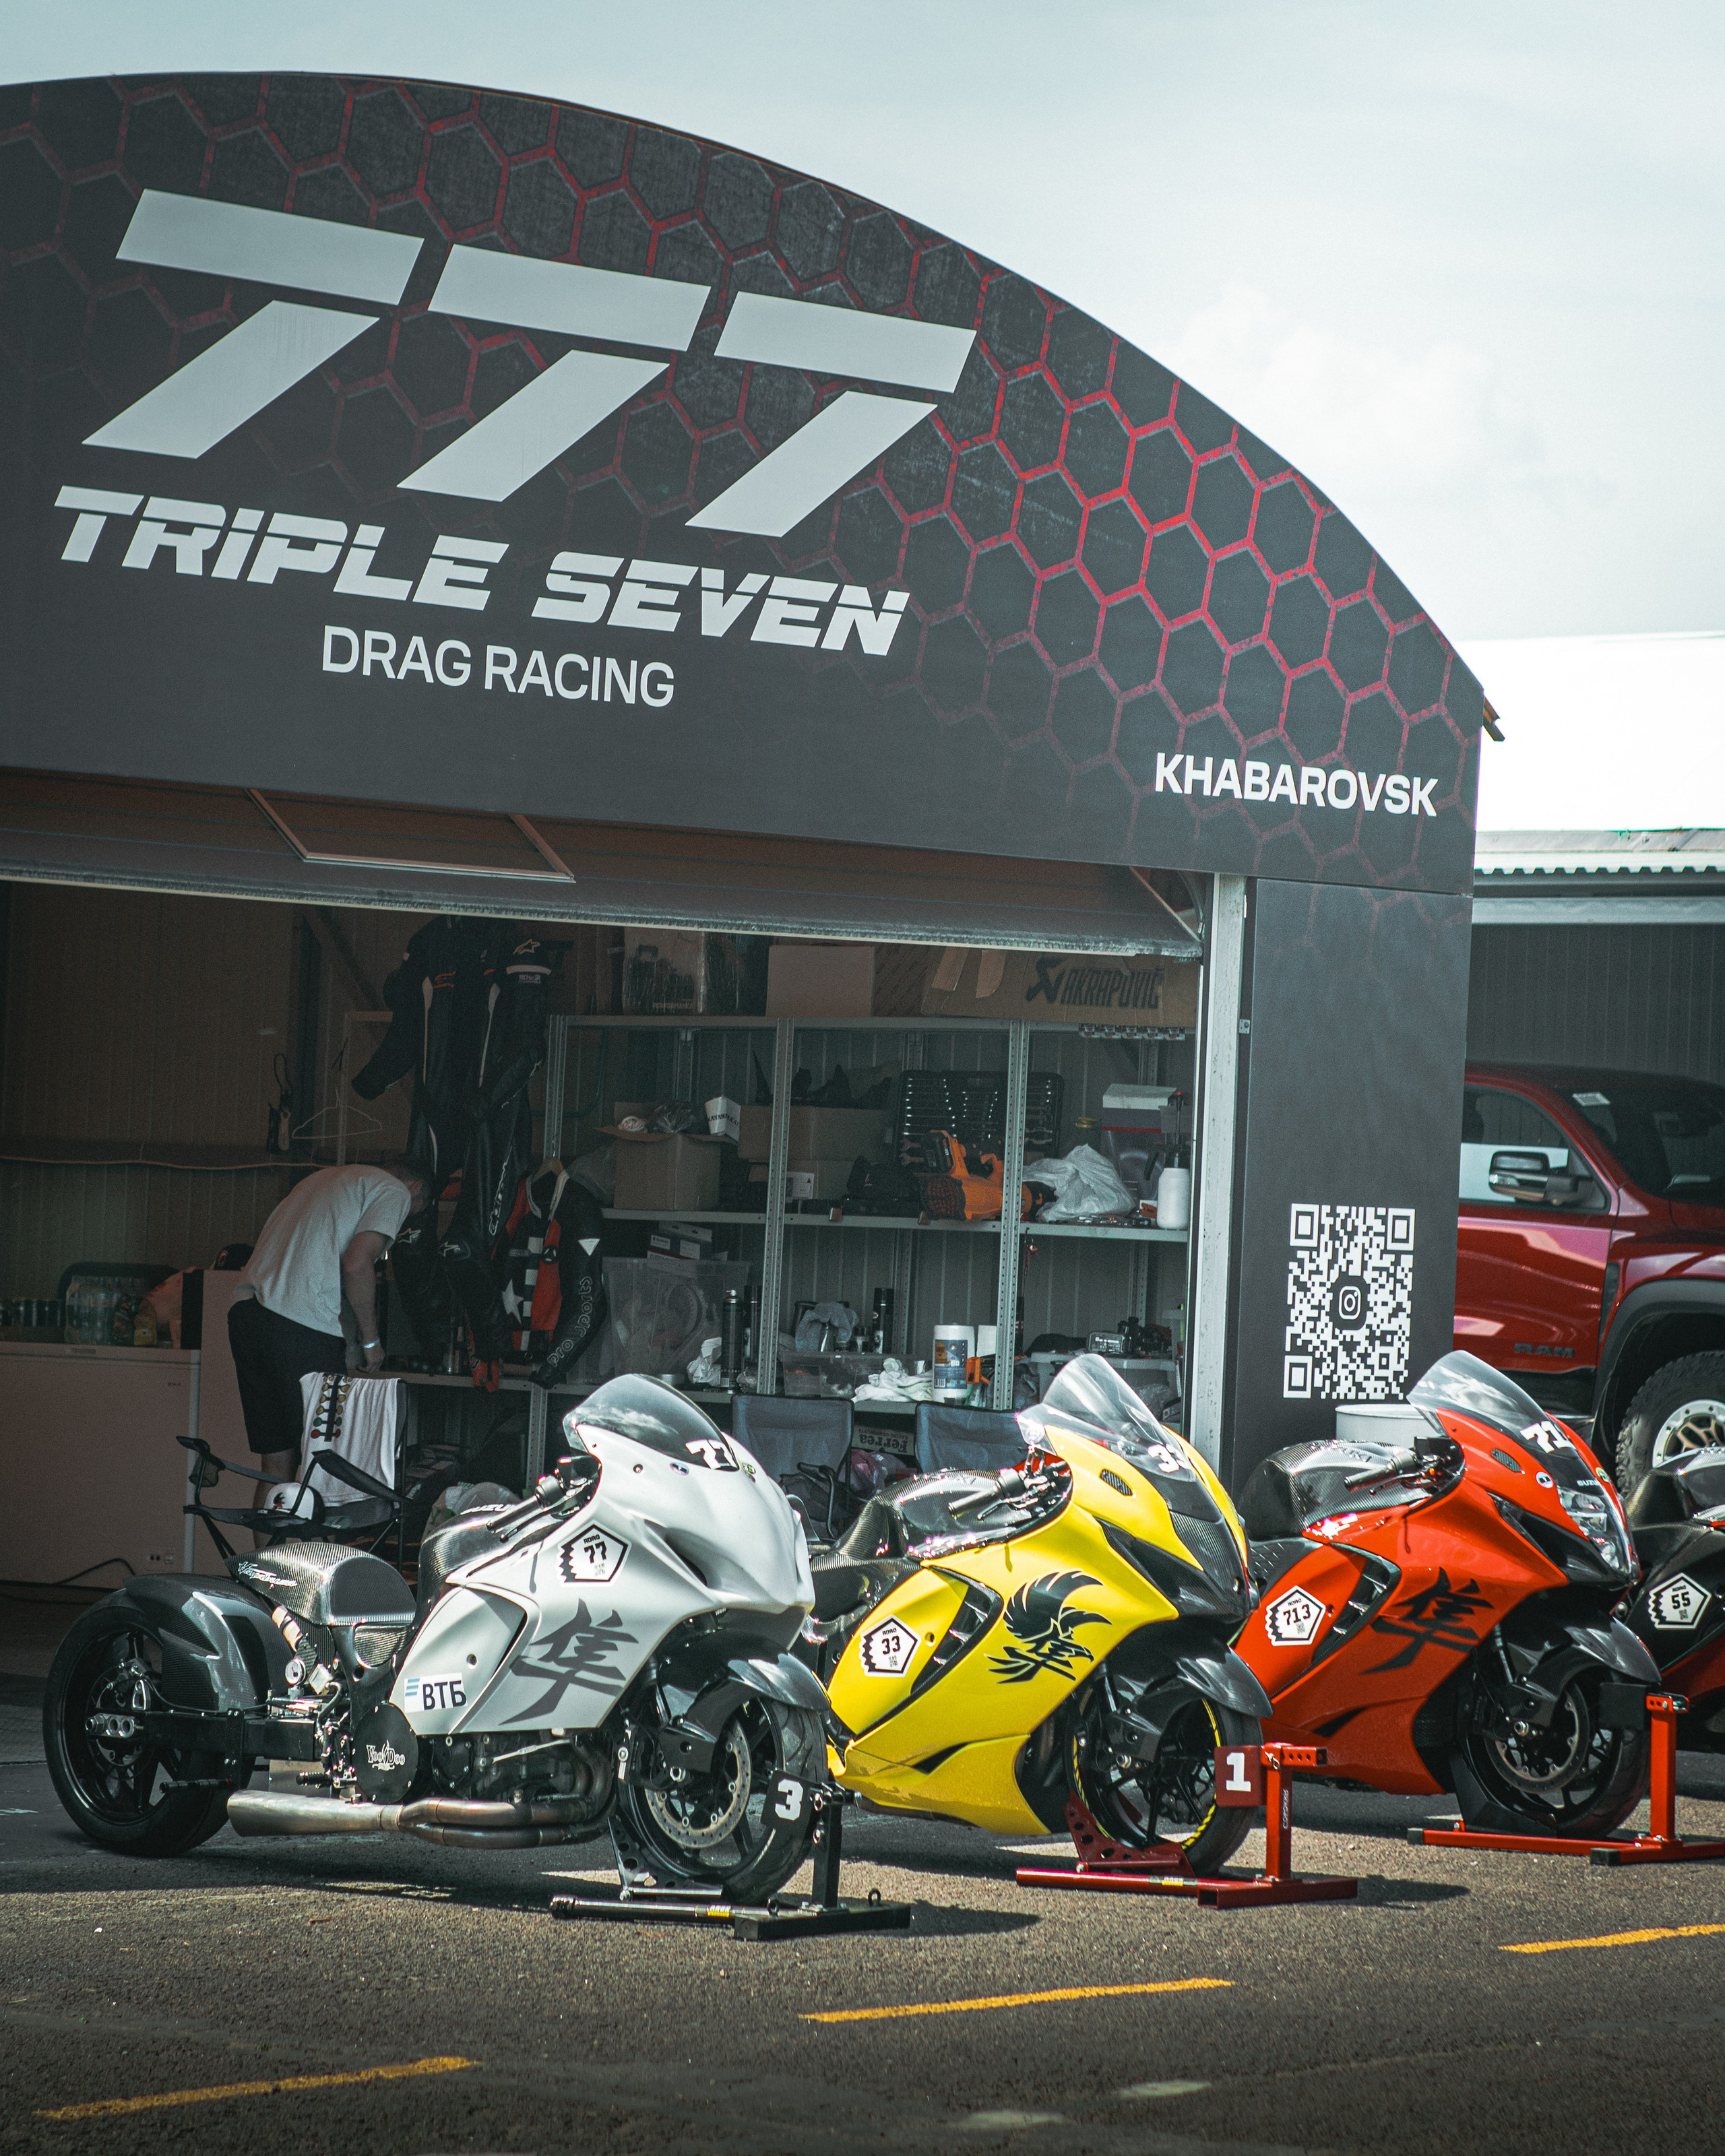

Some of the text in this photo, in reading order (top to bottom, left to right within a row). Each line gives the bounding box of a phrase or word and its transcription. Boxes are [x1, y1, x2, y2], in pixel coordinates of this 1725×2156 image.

[82, 189, 977, 538] 777
[55, 485, 910, 656] TRIPLE SEVEN
[321, 625, 676, 707] DRAG RACING
[1155, 752, 1438, 817] KHABAROVSK
[1514, 1343, 1574, 1358] RAM
[859, 1434, 908, 1453] Ferrea
[584, 1540, 607, 1564] 77
[1283, 1604, 1311, 1626] 713
[1671, 1591, 1691, 1610] 55
[881, 1635, 901, 1655] 33
[422, 1680, 467, 1711] ВТБ
[1226, 1752, 1252, 1792] 1
[775, 1779, 804, 1820] 3
